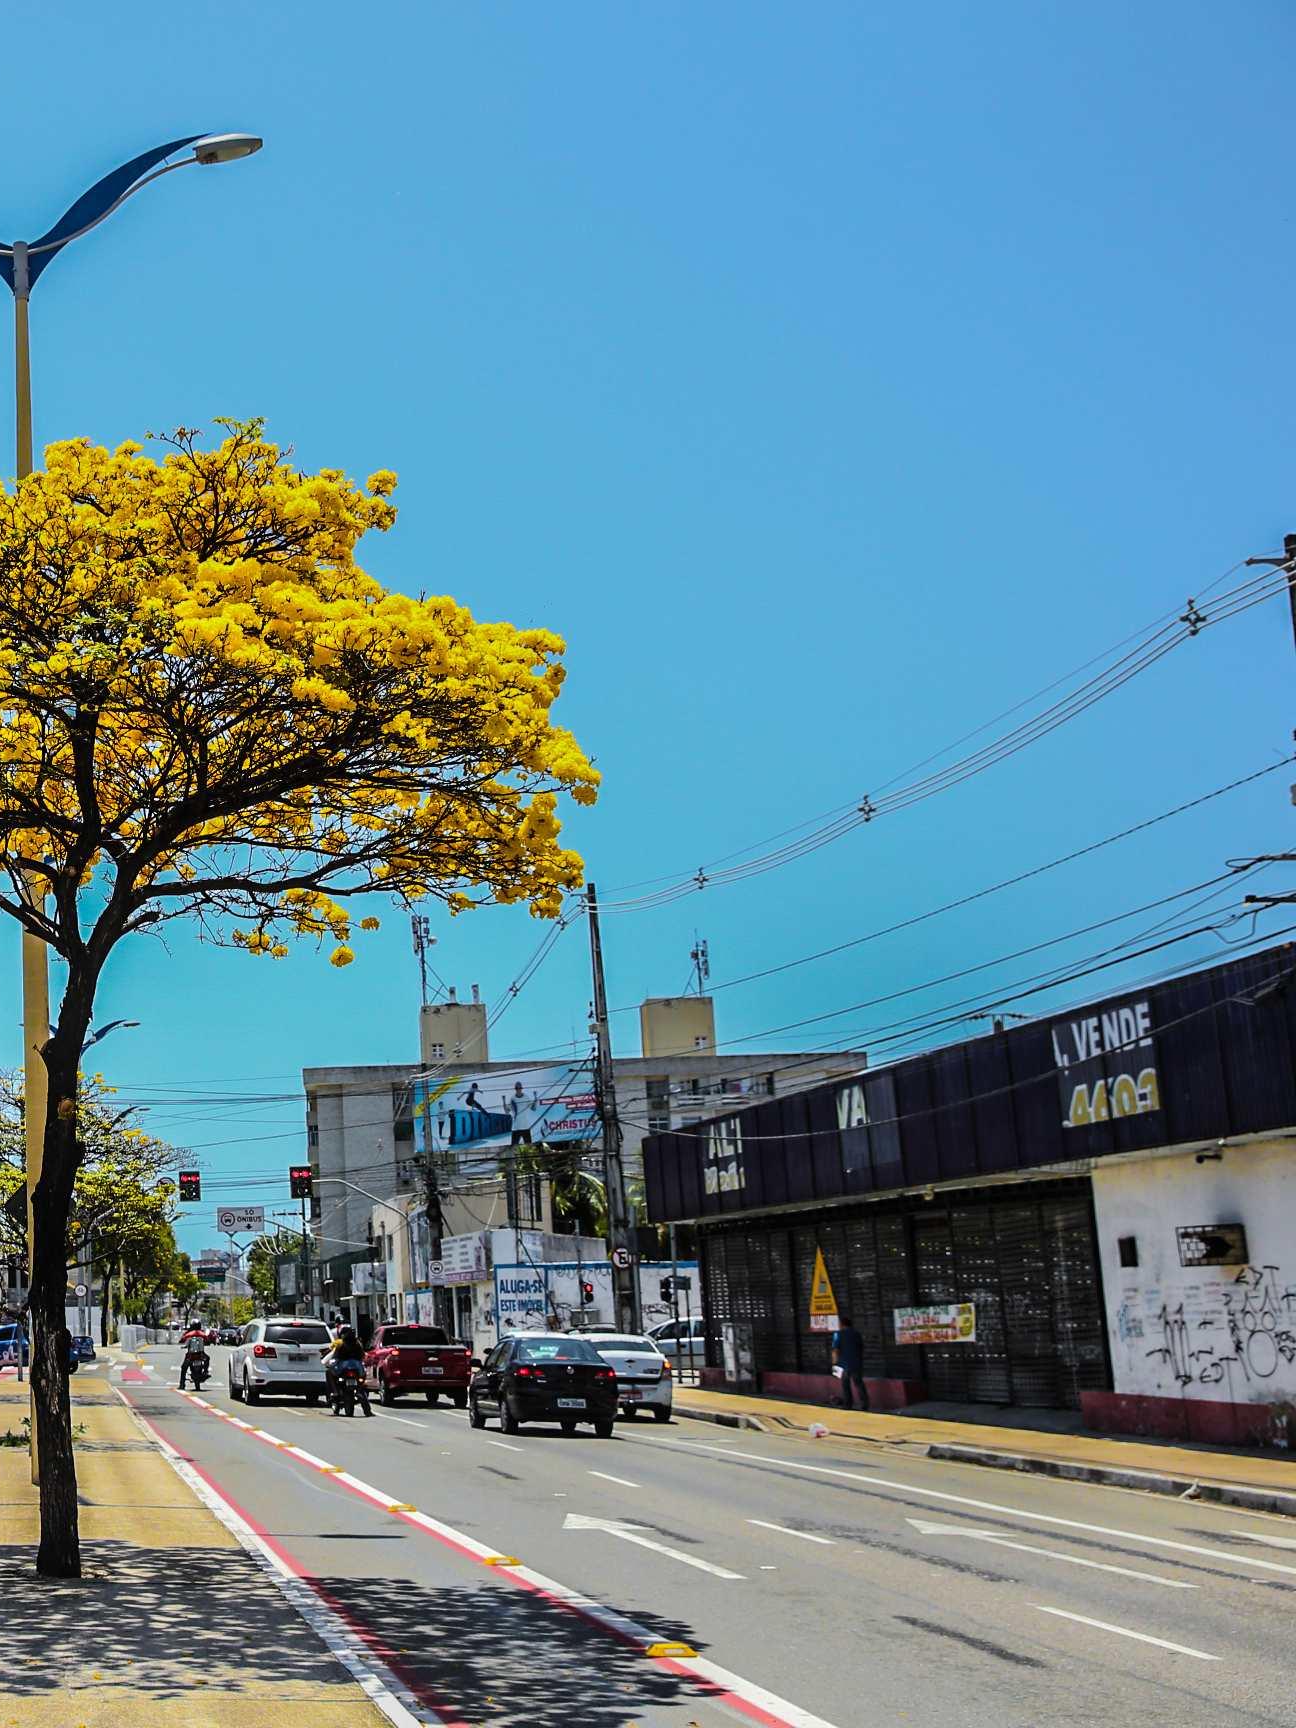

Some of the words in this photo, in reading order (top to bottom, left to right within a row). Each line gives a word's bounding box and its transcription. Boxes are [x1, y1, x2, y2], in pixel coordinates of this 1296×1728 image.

[1071, 1002, 1153, 1061] VENDE
[500, 1279, 544, 1294] ALUGA-SE
[501, 1299, 516, 1312] ESTE
